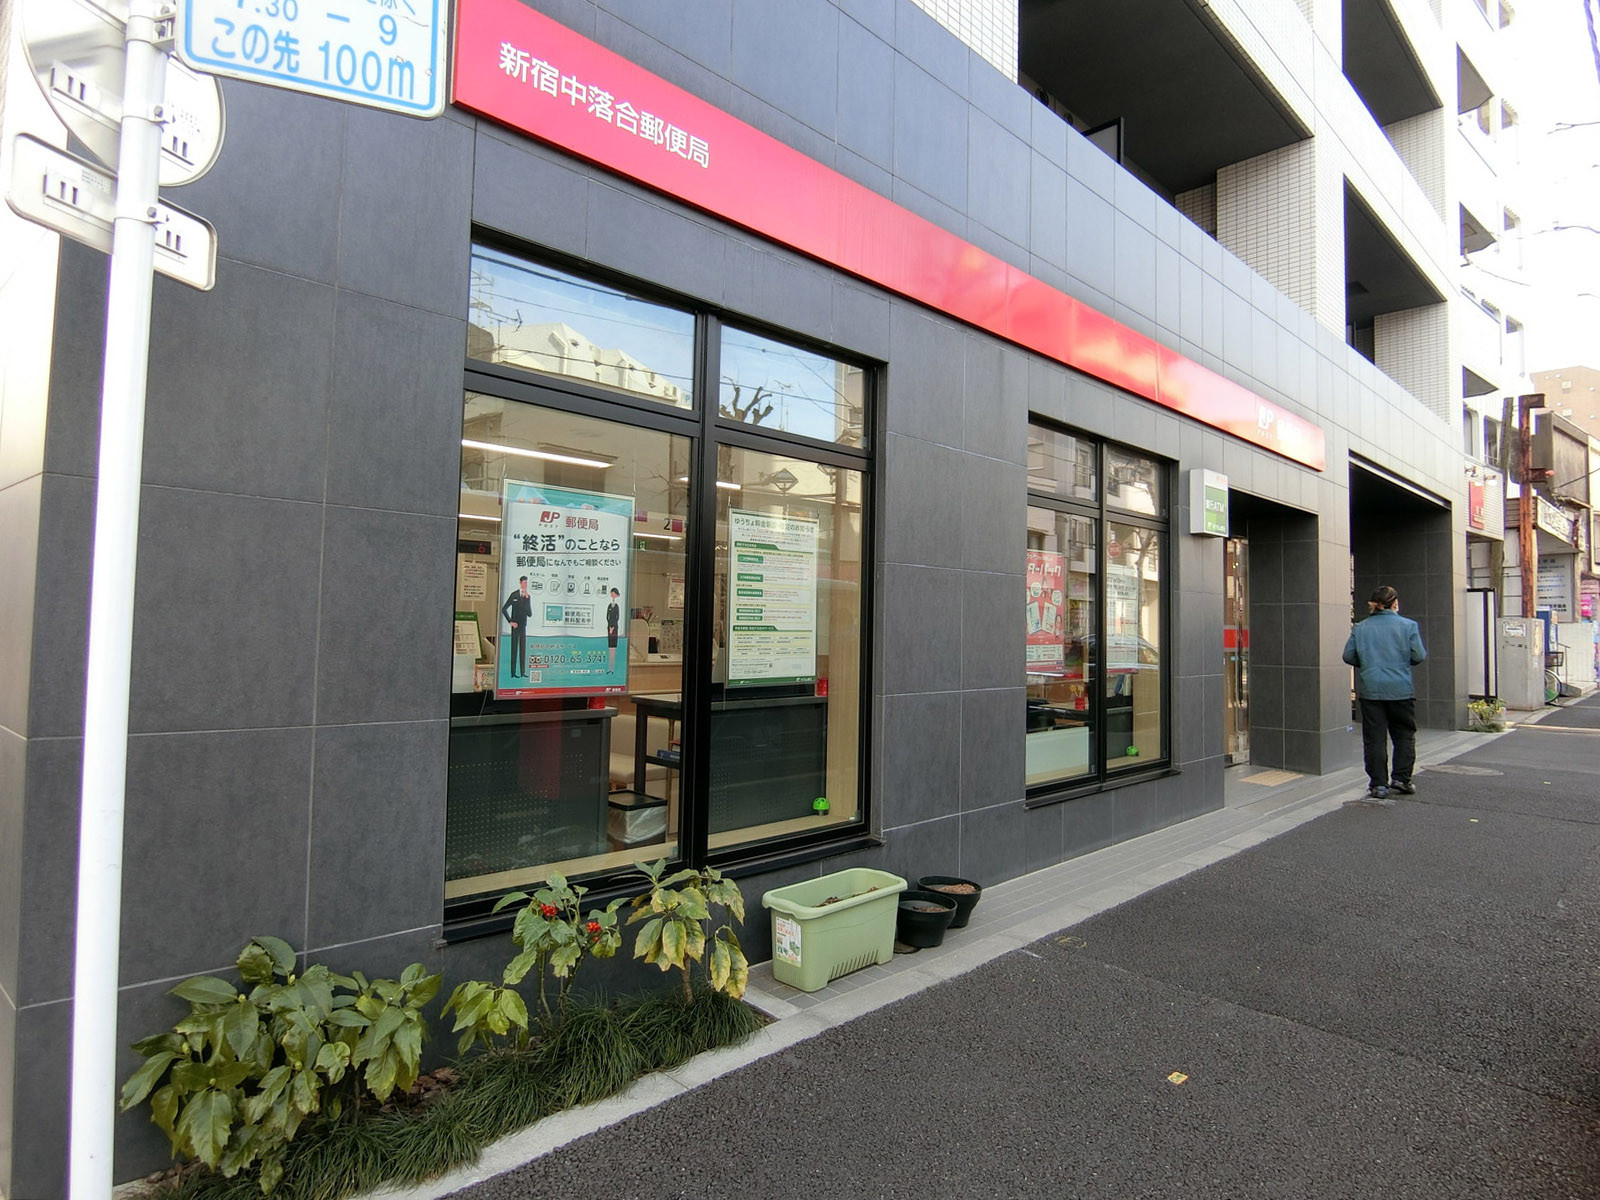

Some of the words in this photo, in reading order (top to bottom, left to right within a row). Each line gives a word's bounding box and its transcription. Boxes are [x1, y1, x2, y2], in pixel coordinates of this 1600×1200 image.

[378, 14, 398, 46] 9
[211, 17, 300, 74] この先
[318, 40, 415, 100] 100m
[498, 41, 711, 169] 新宿中落合郵便局
[540, 510, 561, 524] JP
[565, 515, 600, 531] 郵便局
[663, 517, 672, 531] 2
[516, 556, 622, 568] 郵便局になんでもご相談ください
